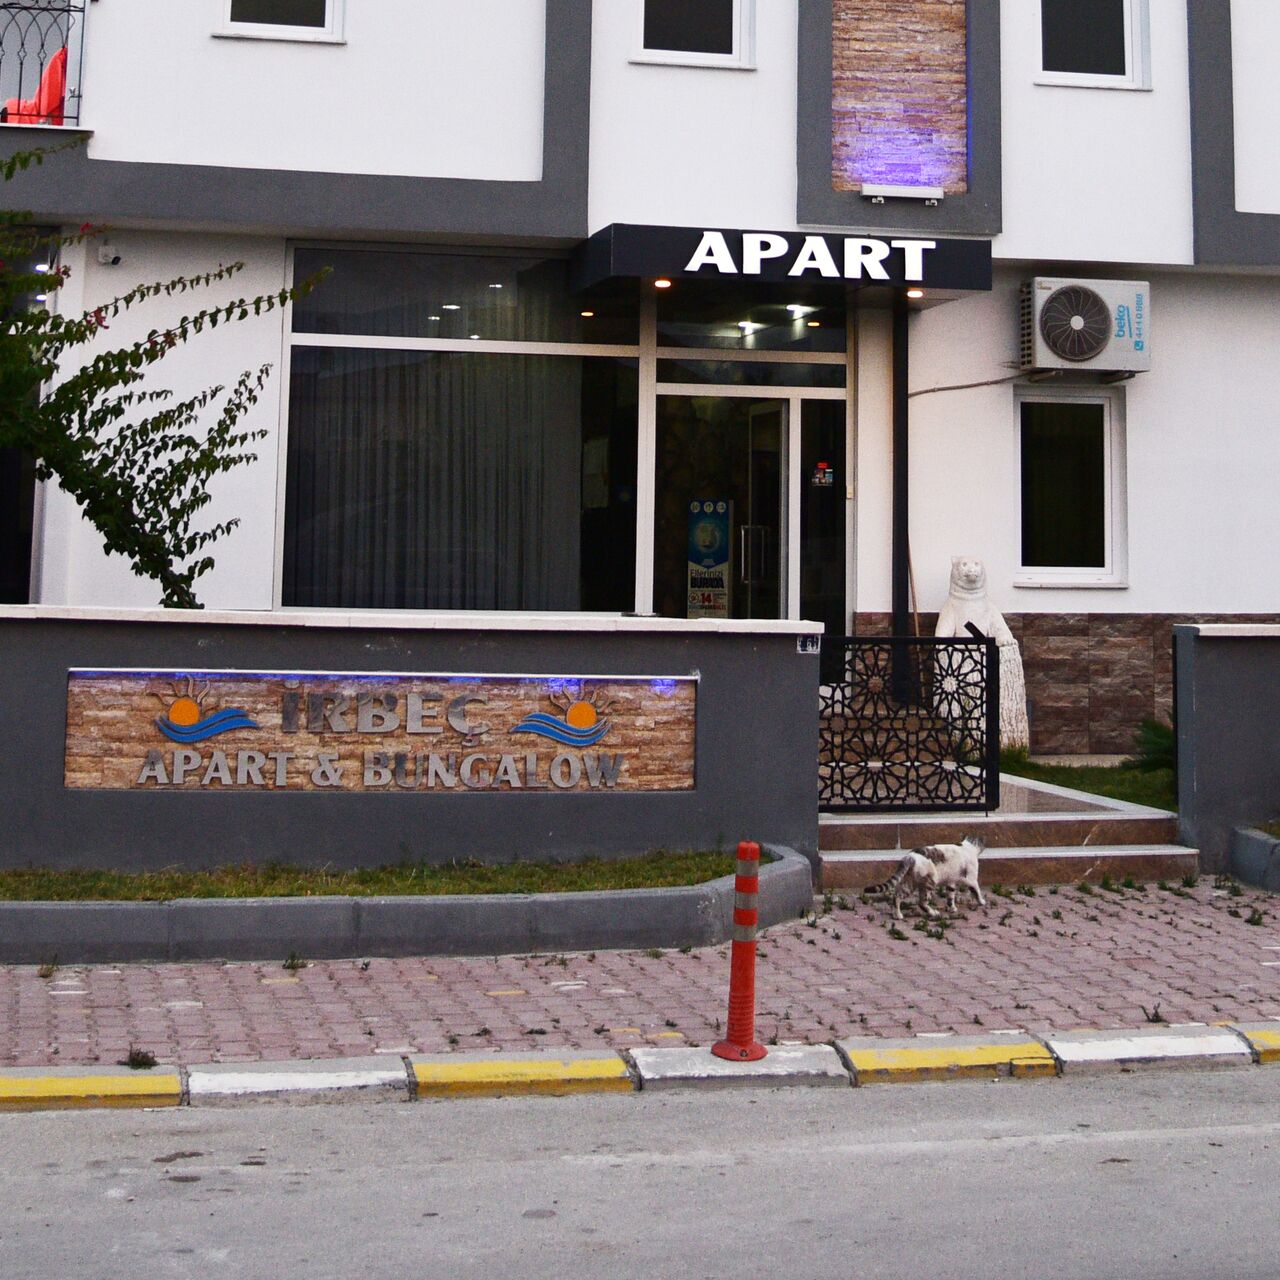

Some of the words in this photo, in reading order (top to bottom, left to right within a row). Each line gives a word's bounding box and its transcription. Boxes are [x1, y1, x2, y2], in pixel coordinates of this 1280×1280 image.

[683, 231, 937, 281] APART
[1115, 304, 1126, 338] beko
[281, 680, 490, 747] İRBEÇ
[136, 748, 296, 787] APART
[311, 752, 344, 786] &
[364, 751, 625, 789] BUNGALOW
